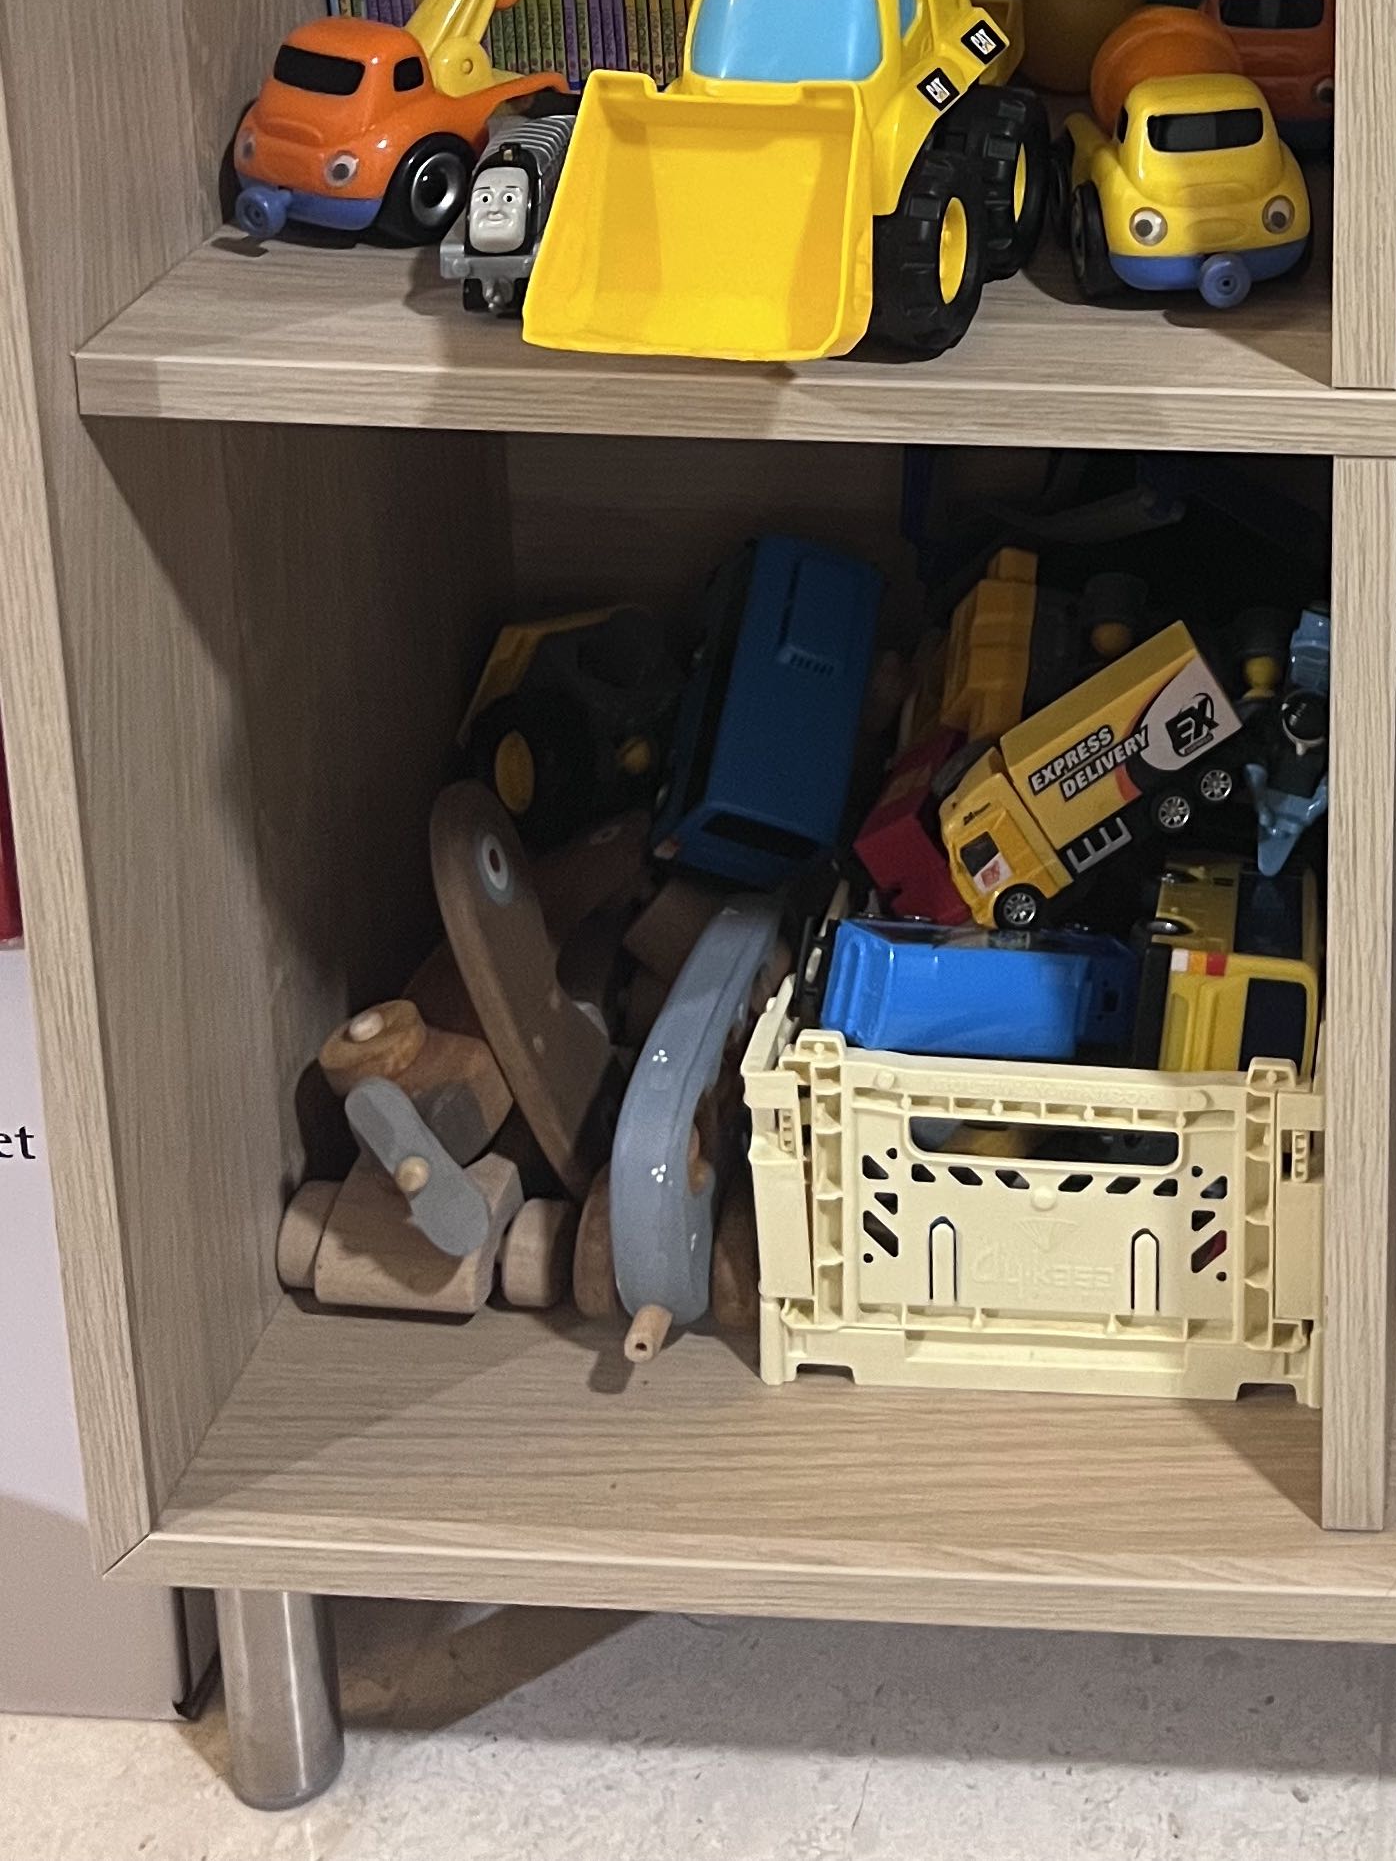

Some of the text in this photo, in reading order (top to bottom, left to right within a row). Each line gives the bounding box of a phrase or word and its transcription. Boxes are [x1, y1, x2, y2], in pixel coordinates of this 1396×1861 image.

[968, 28, 997, 56] CAT
[925, 77, 951, 104] CAT
[1030, 725, 1114, 795] EXPRESS
[1062, 727, 1150, 801] DELIVERY
